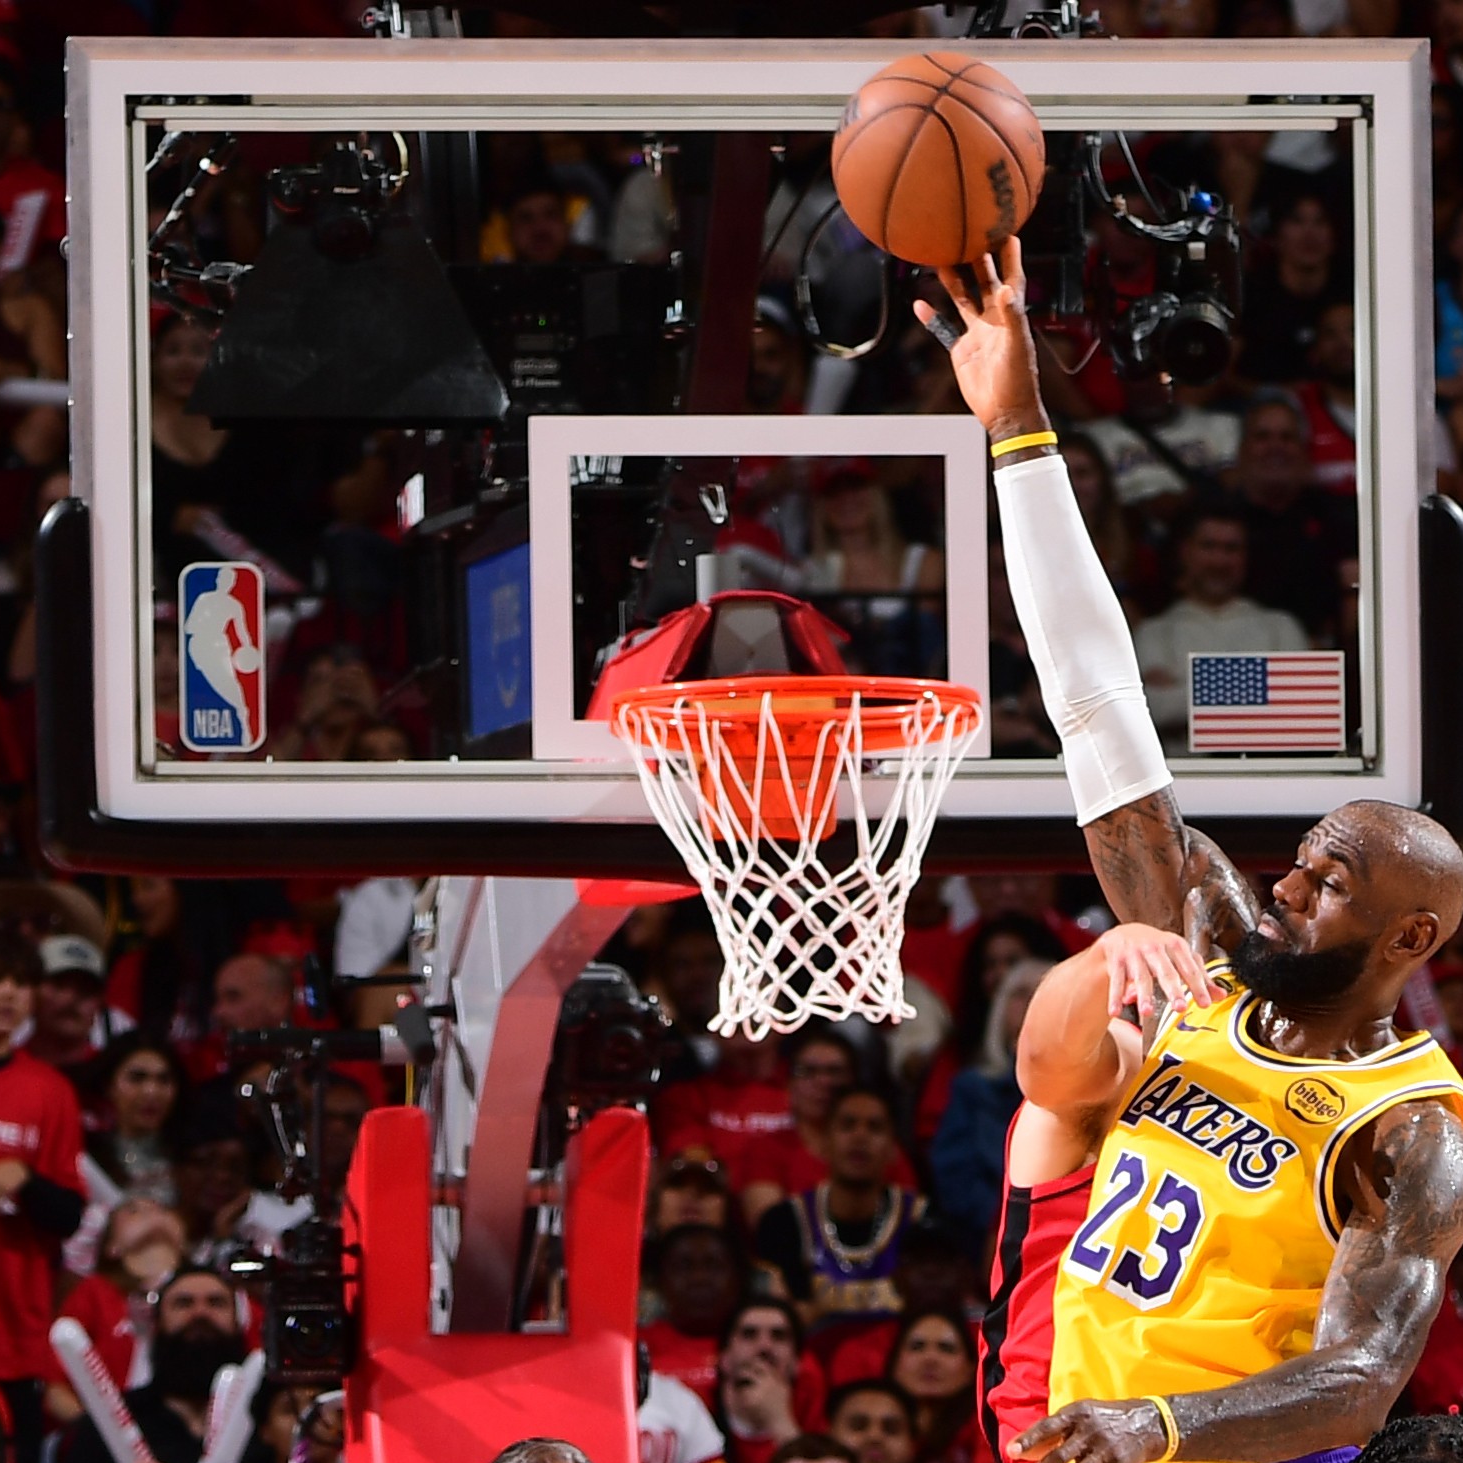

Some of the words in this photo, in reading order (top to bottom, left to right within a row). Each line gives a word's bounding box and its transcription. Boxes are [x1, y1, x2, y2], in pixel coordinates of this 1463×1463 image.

[193, 708, 234, 738] NBA
[1119, 1053, 1300, 1192] LAKERS
[1294, 1083, 1338, 1119] bibigo
[1062, 1149, 1205, 1312] 23
